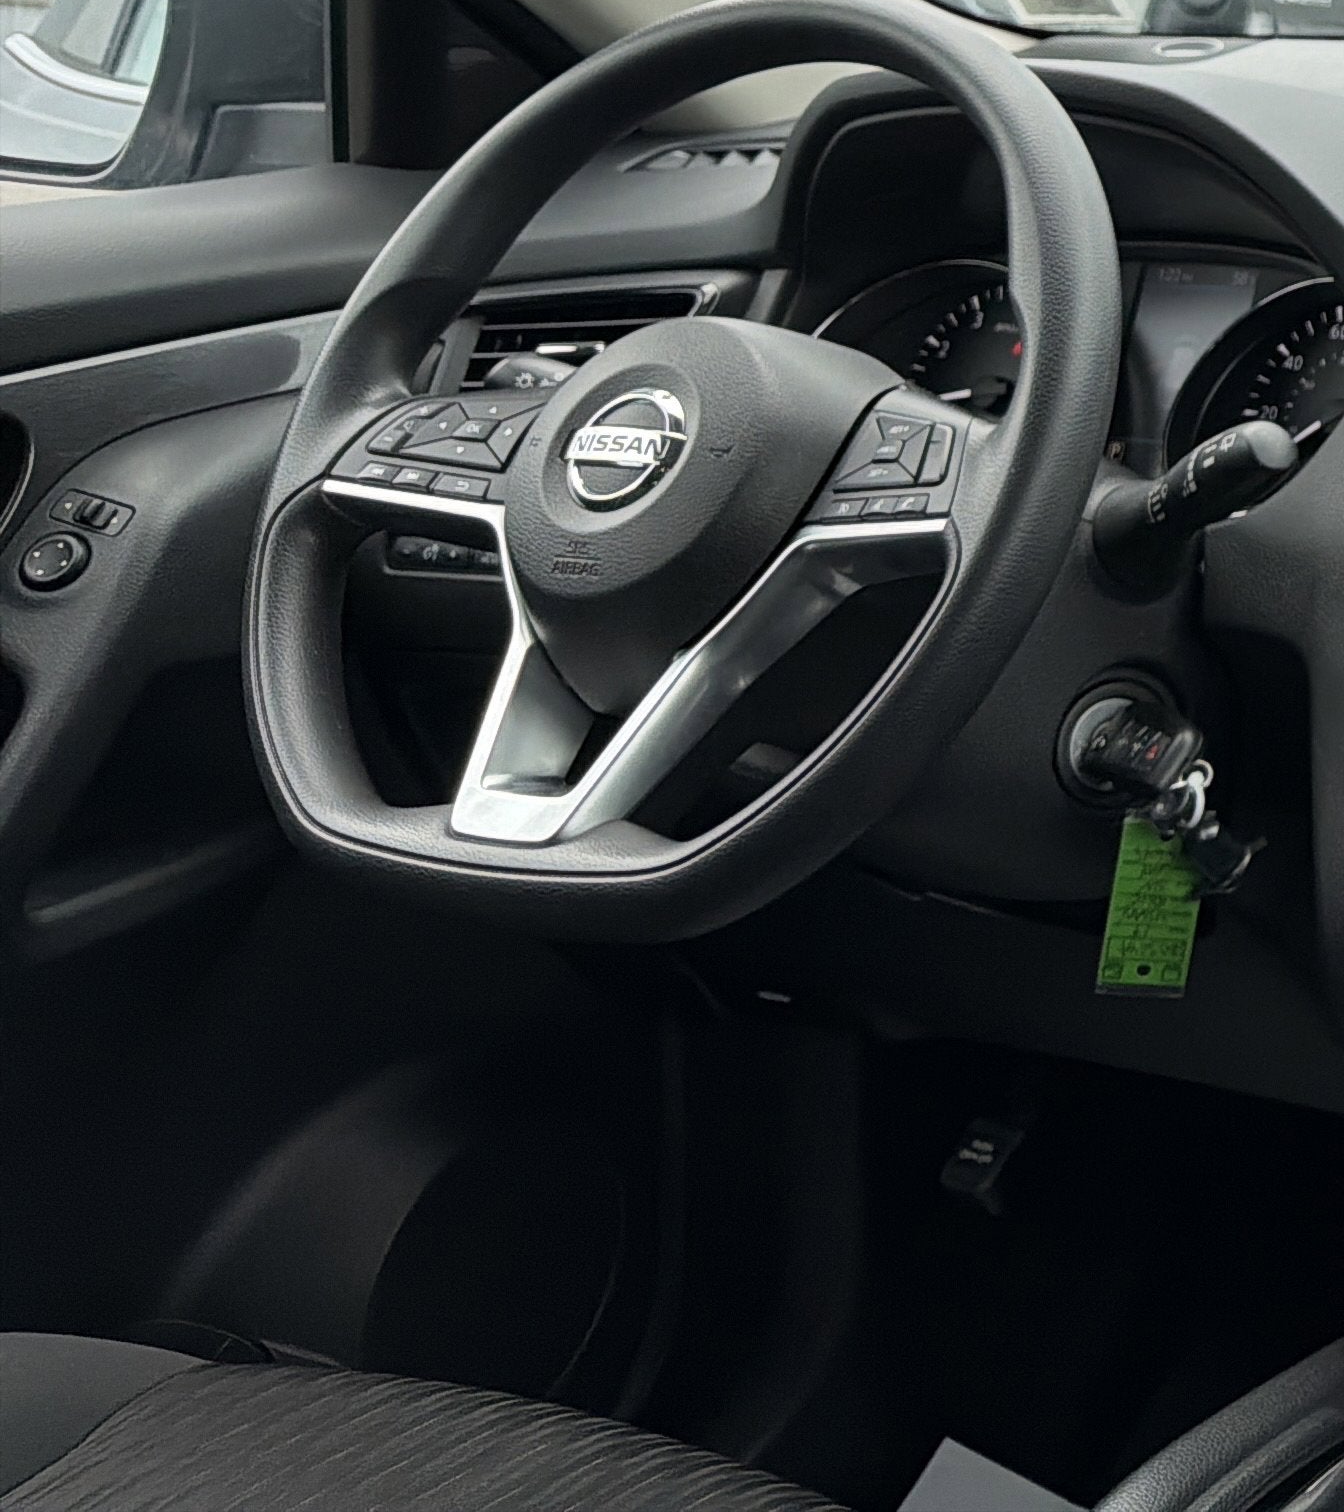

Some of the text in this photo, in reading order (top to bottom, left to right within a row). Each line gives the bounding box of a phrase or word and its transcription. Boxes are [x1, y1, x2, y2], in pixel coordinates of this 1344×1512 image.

[1281, 354, 1304, 372] 40
[1259, 404, 1279, 420] 20
[572, 431, 666, 456] NISSAN
[550, 559, 600, 576] AIRBAG
